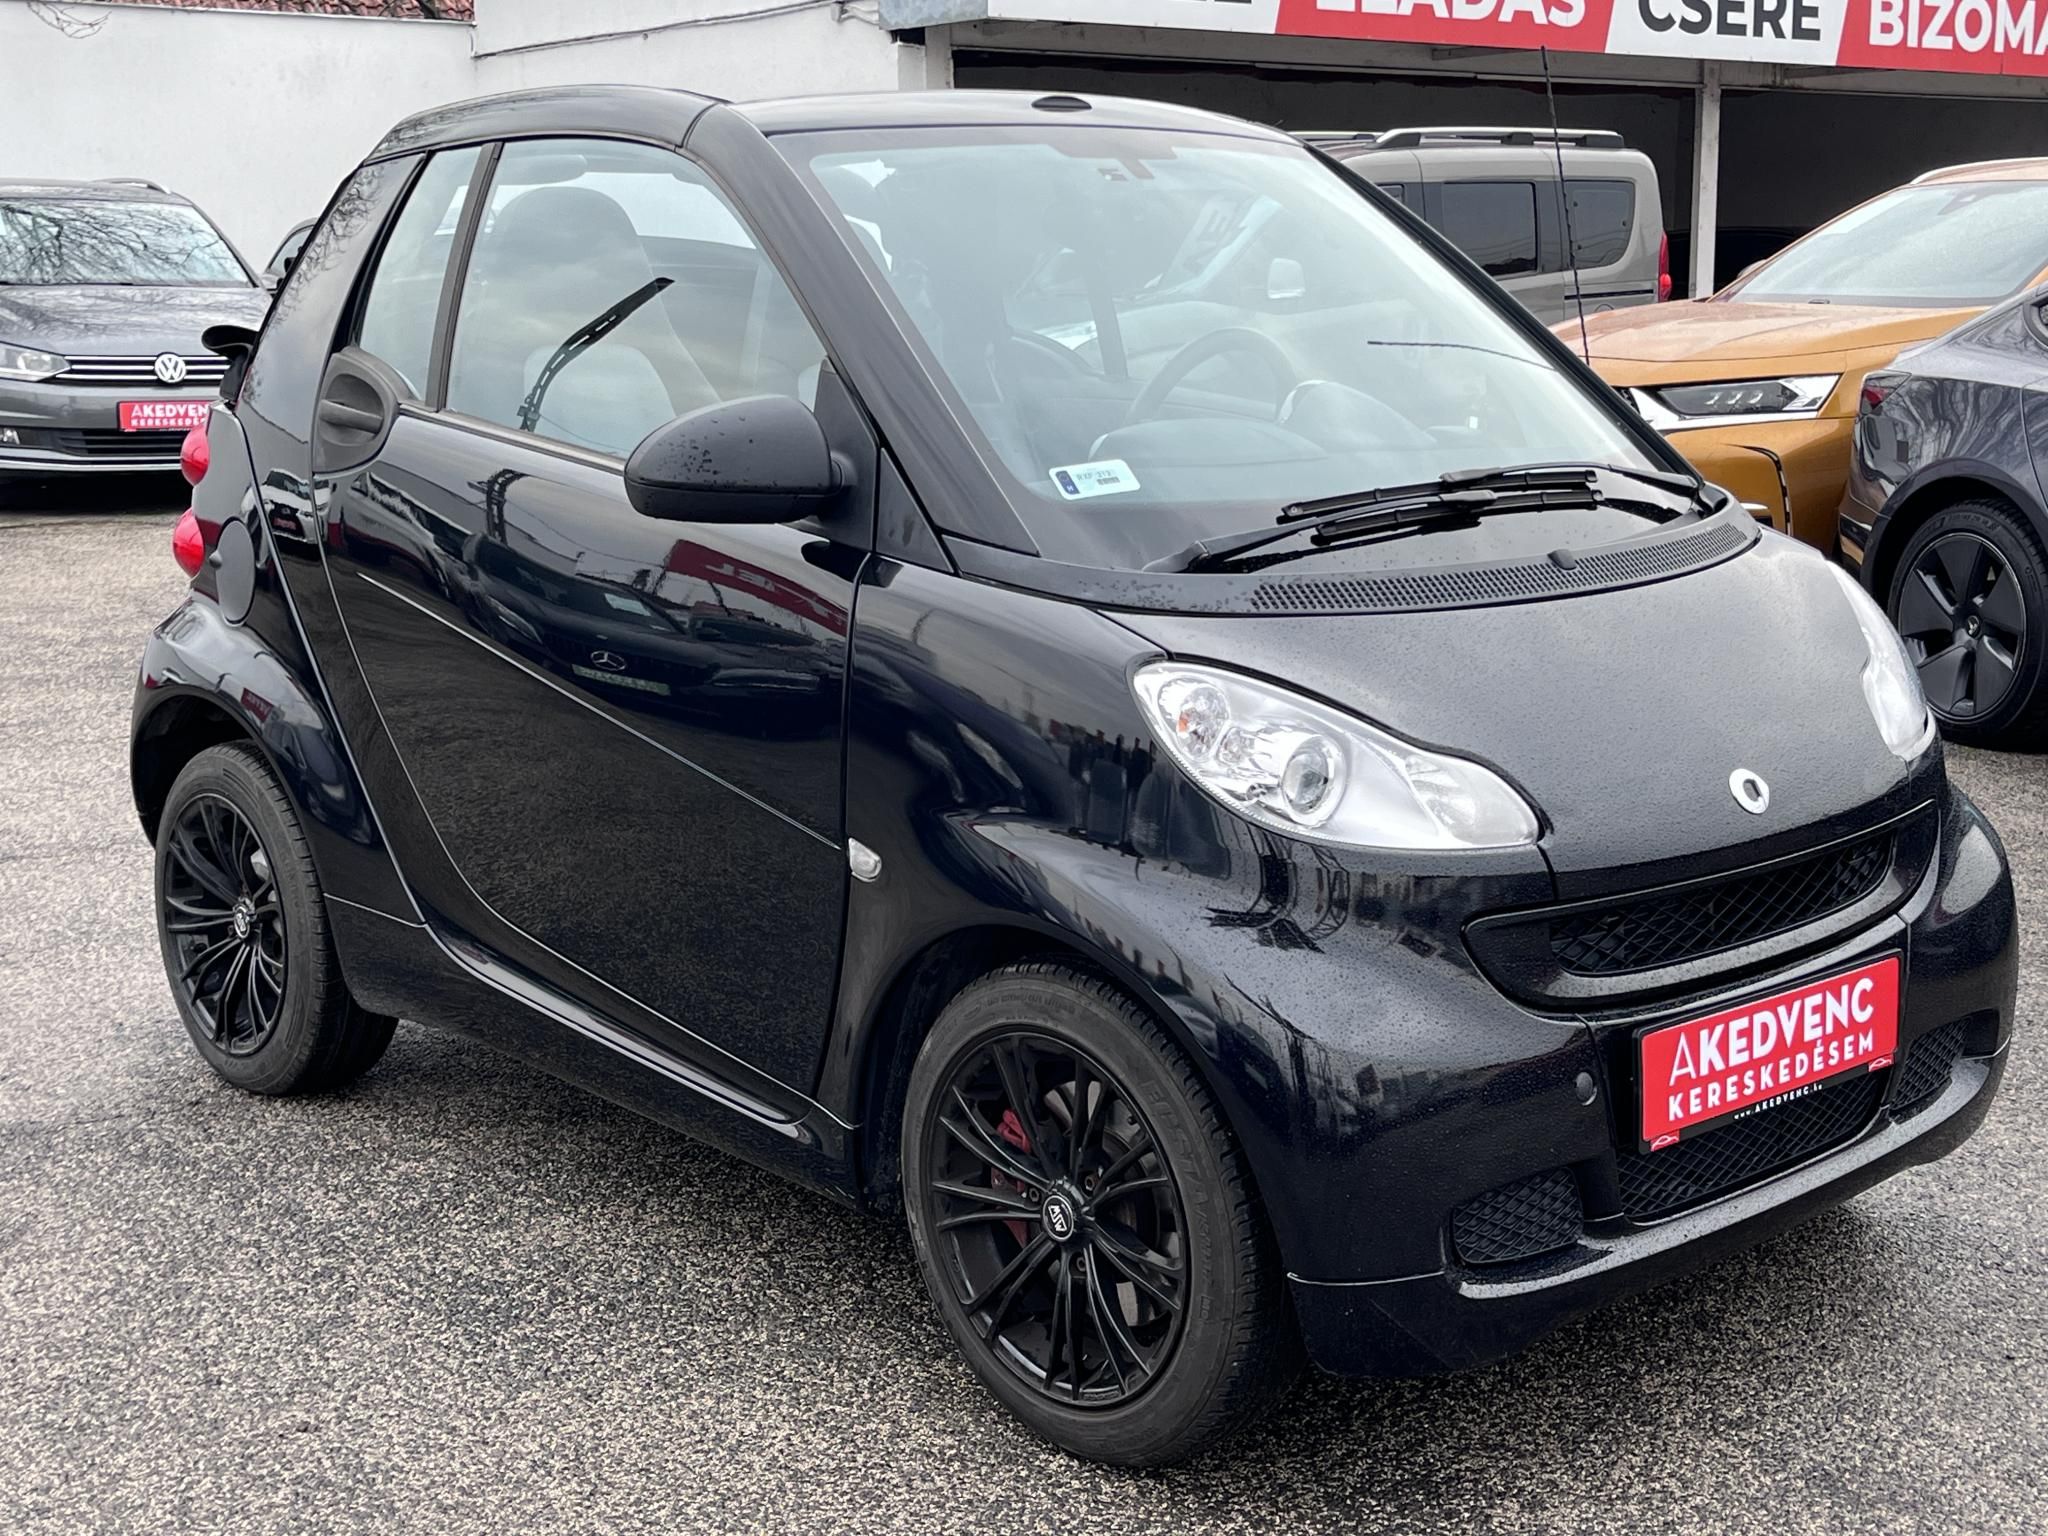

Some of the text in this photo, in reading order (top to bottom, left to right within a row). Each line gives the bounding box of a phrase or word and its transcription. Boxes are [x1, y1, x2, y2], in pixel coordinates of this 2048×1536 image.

[1638, 0, 1821, 41] CSERE
[131, 404, 208, 417] AKEDVEN
[1668, 1028, 1873, 1121] KERESKEDÉSEM
